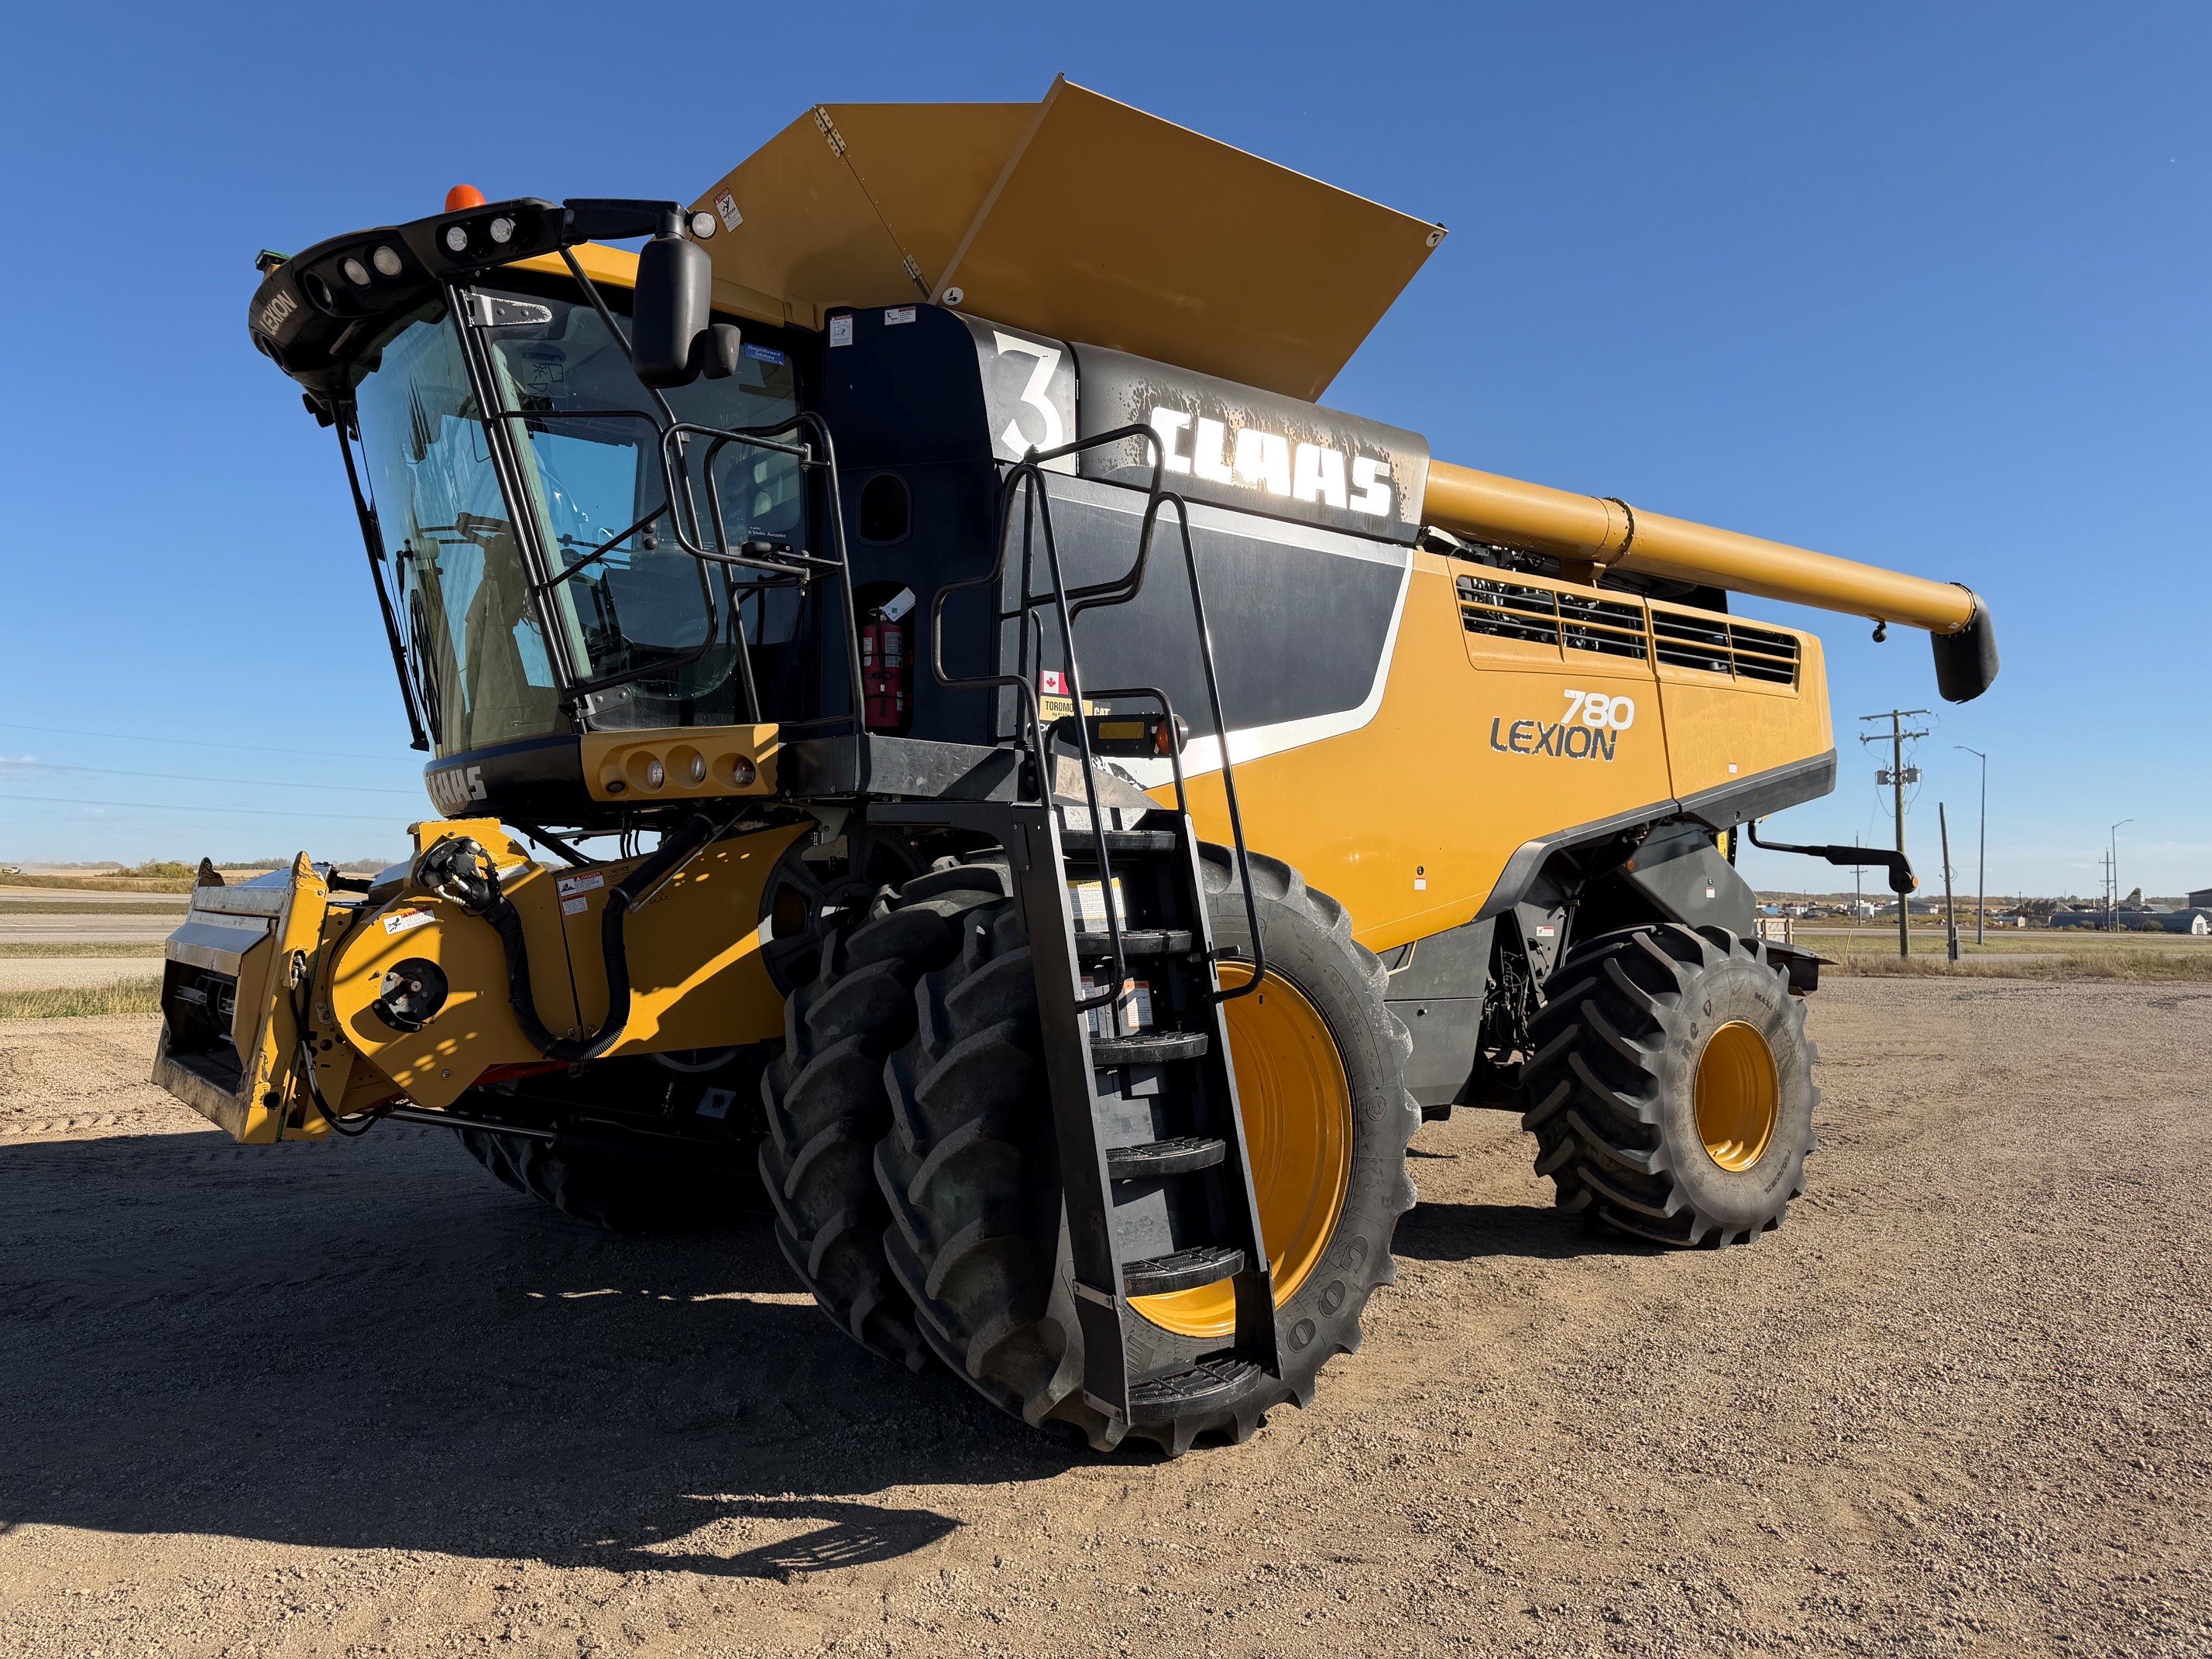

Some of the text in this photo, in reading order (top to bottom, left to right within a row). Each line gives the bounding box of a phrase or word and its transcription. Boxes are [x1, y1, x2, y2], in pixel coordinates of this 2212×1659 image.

[259, 290, 297, 336] LEXION
[993, 330, 1063, 456] 3
[1147, 407, 1391, 517] CLAAS
[1045, 700, 1111, 716] TOROMO CAT
[1561, 689, 1635, 730] 780
[1490, 716, 1617, 762] LEXION
[581, 871, 601, 880] DANGER
[610, 866, 630, 874] NOTICE
[407, 906, 431, 915] WARNING
[1764, 1149, 1791, 1195] 750/65R26
